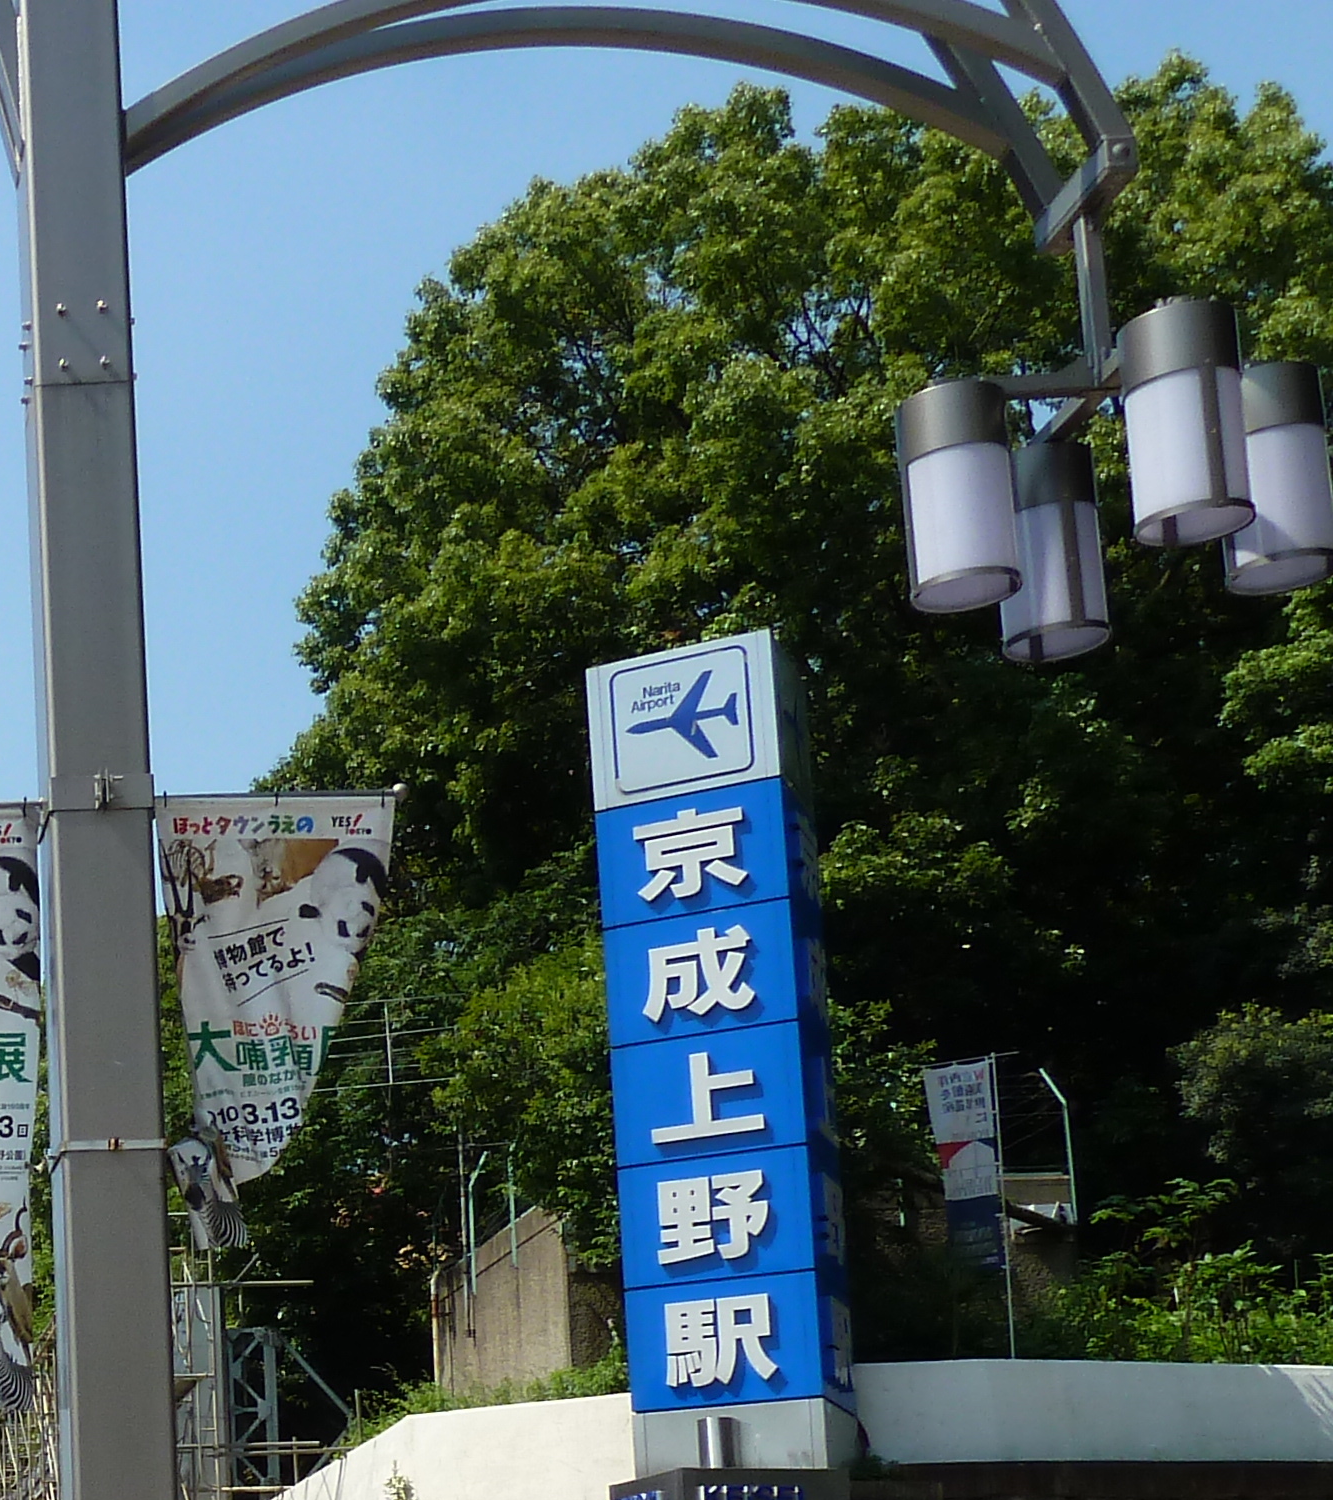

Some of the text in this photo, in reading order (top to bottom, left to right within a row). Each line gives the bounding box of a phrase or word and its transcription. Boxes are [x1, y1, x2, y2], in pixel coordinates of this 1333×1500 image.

[642, 682, 681, 700] Narita
[631, 694, 675, 713] Airport
[173, 814, 315, 835] ほっとタウンうえの
[345, 827, 373, 835] TOKYO
[213, 926, 286, 971] 博物館で
[221, 942, 316, 993] 待ってるよ!
[632, 806, 779, 1388] 京成上野駅
[242, 1097, 300, 1125] 3.13
